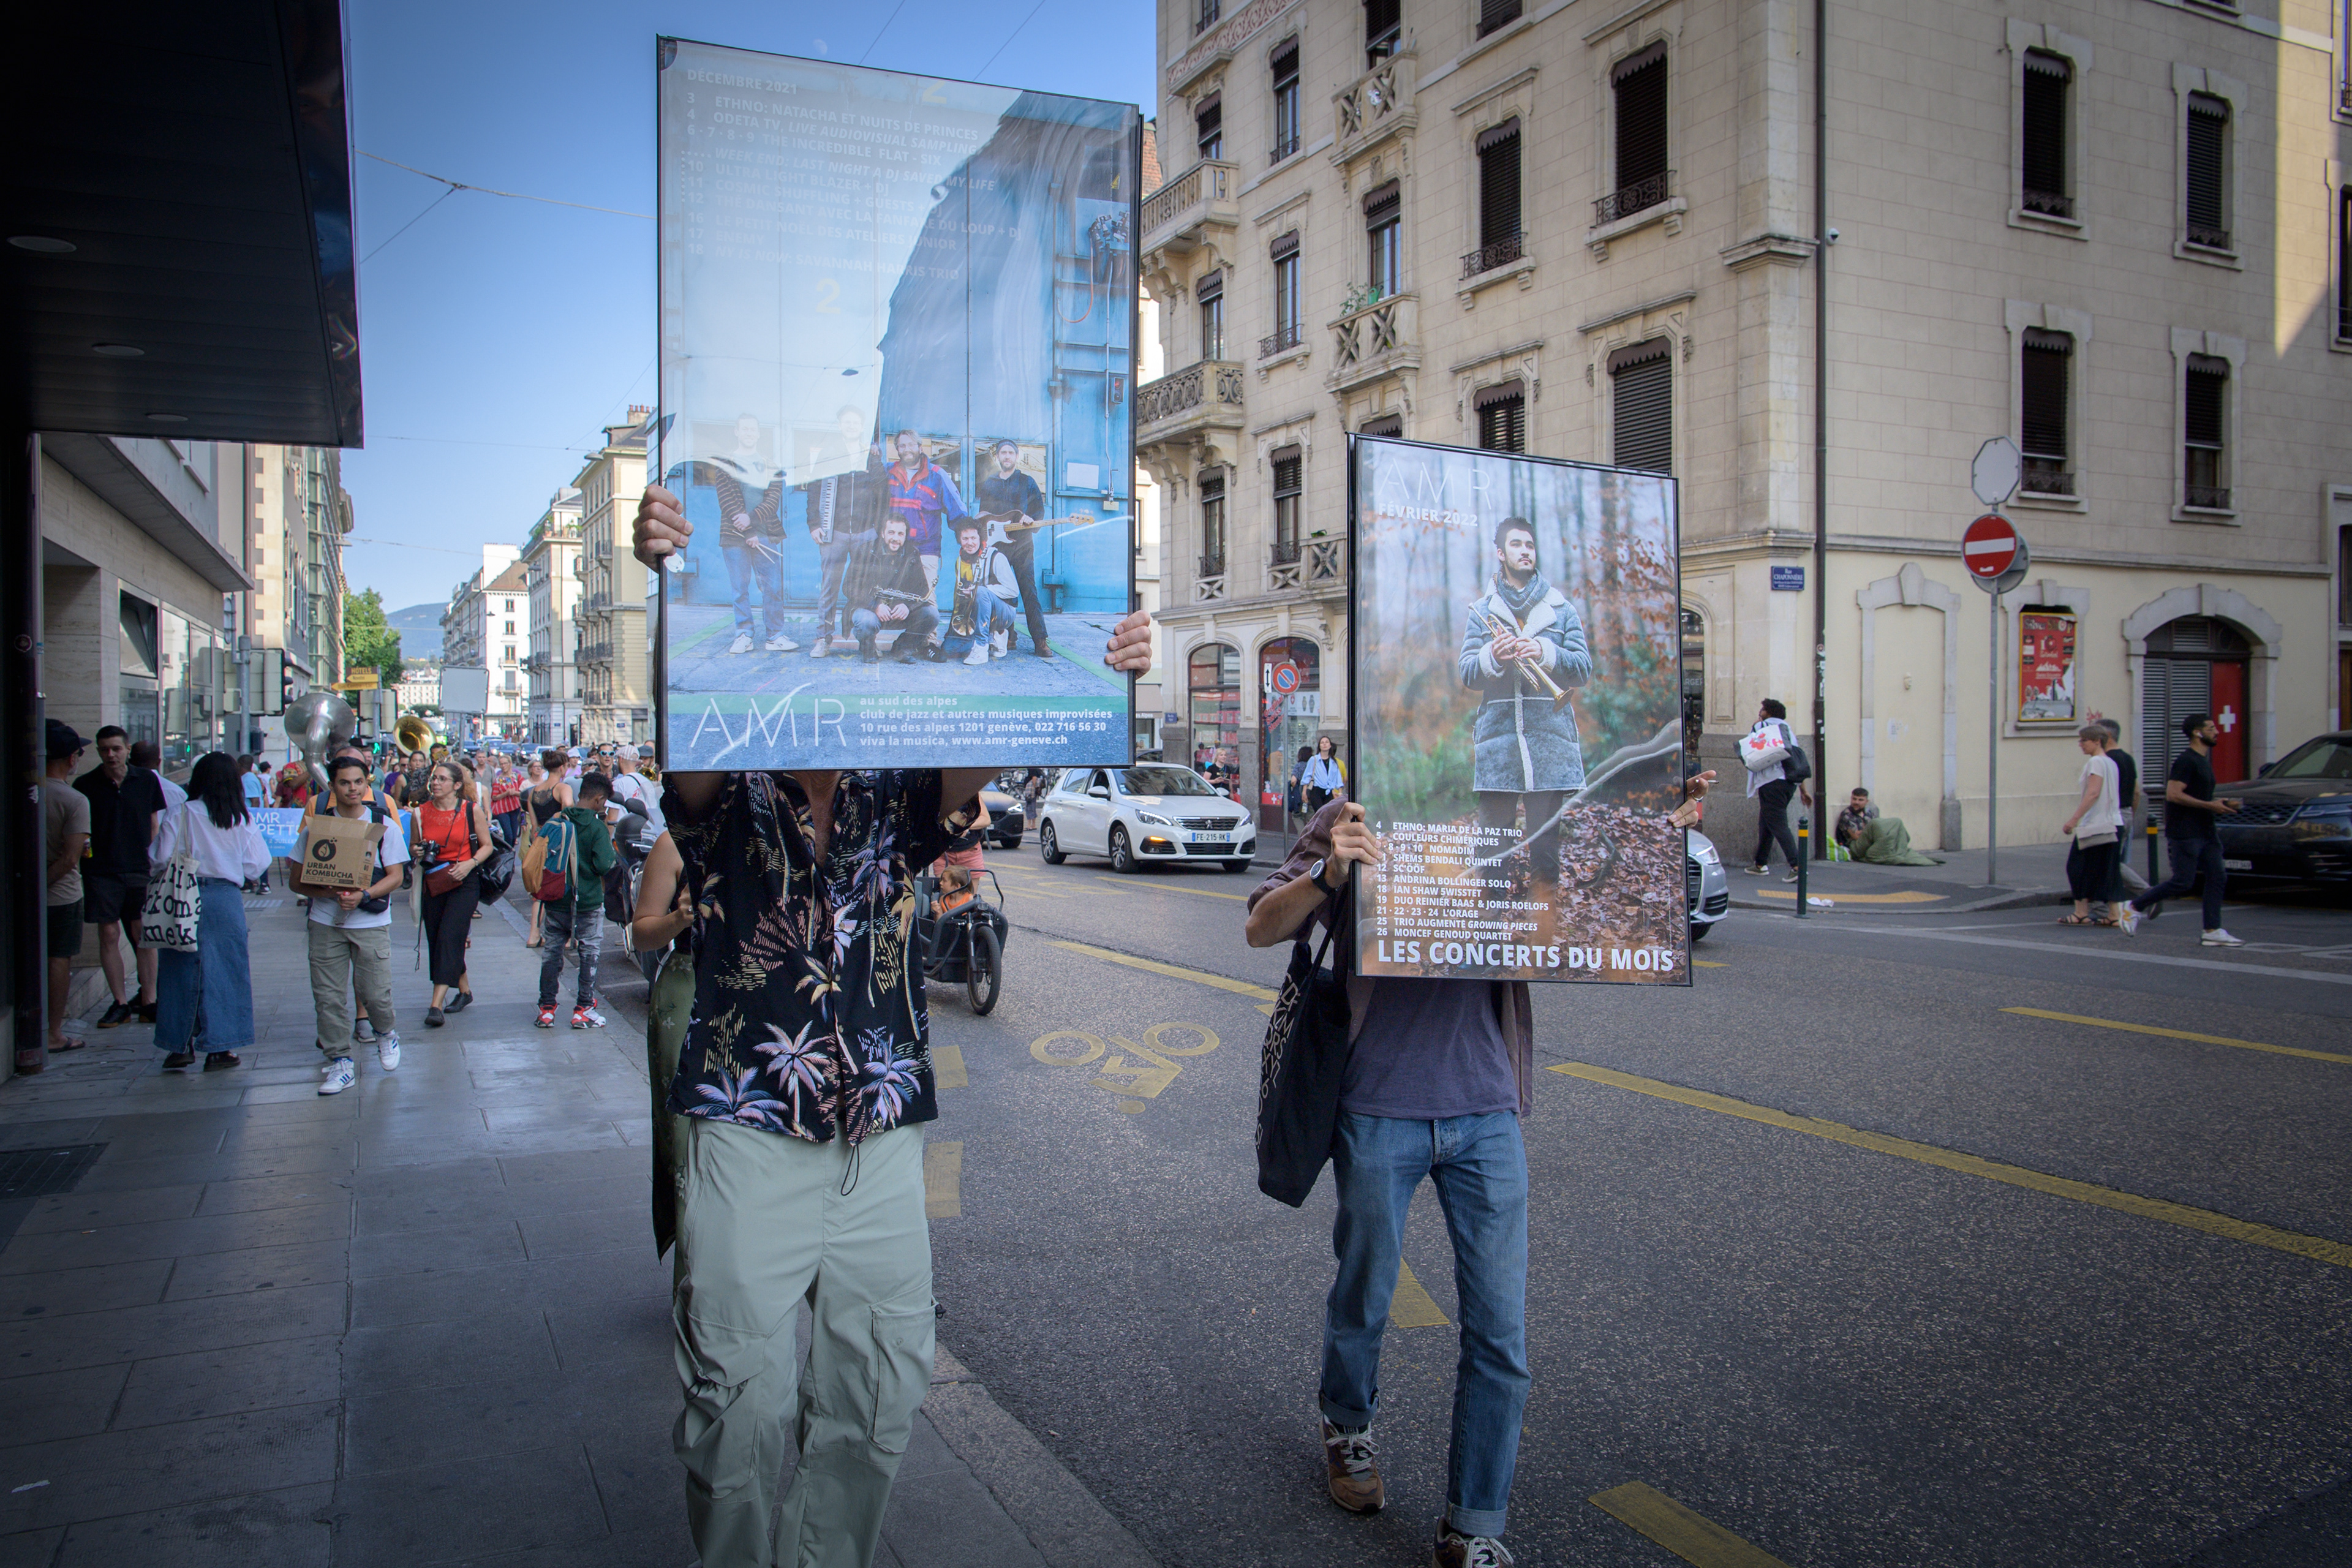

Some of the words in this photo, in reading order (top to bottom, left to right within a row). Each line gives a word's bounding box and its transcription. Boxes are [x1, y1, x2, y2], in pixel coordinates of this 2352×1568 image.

[687, 68, 761, 90] DÉCEMBRE
[766, 80, 796, 94] 2021
[715, 96, 767, 113] ETHNO:
[772, 104, 837, 122] NATACHA
[842, 113, 856, 124] ET
[860, 115, 900, 130] NUITS
[904, 121, 920, 133] DE
[924, 124, 978, 140] PRINCES
[714, 111, 760, 128] ODETA
[763, 118, 783, 133] TV,
[788, 121, 817, 135] LIVE
[820, 126, 907, 146] AUDIOVISUAL
[911, 137, 977, 154] SAMPLING
[763, 134, 788, 147] THE
[793, 137, 872, 157] INCREDIBLE
[879, 148, 909, 162] FLAT
[921, 154, 941, 166] SIX
[715, 148, 753, 162] WEEK
[756, 153, 789, 167] END:
[793, 157, 825, 171] LAST
[828, 161, 870, 176] NIGHT
[886, 168, 899, 183] DJ
[903, 170, 943, 184] SAVED
[946, 176, 966, 187] MY
[968, 178, 995, 191] LIFE
[688, 160, 704, 172] 10
[715, 163, 761, 179] ULTRA
[766, 169, 806, 184] LIGHT
[810, 175, 861, 191] BLAZER
[876, 183, 888, 197] DJ
[688, 176, 703, 187] 11
[715, 179, 770, 195] COSMIC
[774, 186, 850, 205] SHUFFLING
[865, 197, 914, 211] GUESTS
[688, 192, 704, 204] 12
[715, 194, 742, 208] THÉ
[746, 198, 813, 216] DANSANT
[817, 206, 851, 220] AVEC
[856, 211, 873, 222] LA
[938, 219, 957, 232] DU
[961, 222, 995, 235] LOUP
[1009, 227, 1022, 241] DJ
[688, 212, 703, 224] 16
[716, 214, 731, 227] LE
[736, 217, 772, 231] PETIT
[777, 221, 813, 235] NOËL
[818, 225, 842, 238] DES
[846, 228, 905, 244] ATELIERS
[688, 227, 704, 239] 17
[716, 230, 765, 245] ENEMY
[688, 243, 704, 254] 18
[796, 254, 872, 271] SAVANNAH
[929, 267, 959, 280] TRIO
[816, 279, 842, 314] 2
[1378, 458, 1492, 510] AMR
[1379, 502, 1439, 522] FÉVRIER
[1443, 511, 1478, 527] 2022
[878, 696, 899, 706] sud
[903, 696, 923, 706] des
[926, 696, 957, 708] alpes
[690, 697, 846, 748] AMR
[860, 709, 885, 718] club
[889, 709, 903, 718] de
[906, 709, 929, 721] jazz
[932, 710, 944, 718] et
[948, 710, 985, 718] autres
[988, 709, 1042, 721] musiques
[1046, 709, 1112, 721] improvisées
[860, 723, 874, 732] 10
[900, 723, 921, 733] des
[924, 722, 955, 734] alpes
[959, 723, 984, 732] 1201
[987, 722, 1031, 734] genève,
[1035, 722, 1054, 731] 022
[1057, 722, 1076, 731] 716
[1079, 722, 1091, 731] 56
[1094, 722, 1106, 731] 30
[860, 736, 886, 746] viva
[889, 736, 899, 745] la
[903, 736, 948, 747] musica,
[952, 735, 1068, 747] www.amr-geneve.ch
[1393, 822, 1425, 831] ETHNO:
[1428, 824, 1457, 834] MARIA
[1472, 826, 1483, 835] LA
[1502, 829, 1523, 837] TRIO
[1393, 832, 1438, 843] COULEURS
[1440, 834, 1499, 846] CHIMÉRIQUES
[1430, 845, 1475, 855] NOMADIM
[1393, 853, 1423, 862] SHEMS
[1425, 855, 1462, 865] BENDALI
[1464, 857, 1502, 867] QUINTET
[1393, 863, 1425, 873] SC'ÖÖF
[306, 869, 353, 879] KOMBUCHA
[1393, 875, 1436, 885] ANDRINA
[1438, 877, 1487, 888] BOLLINGER
[1488, 880, 1511, 888] SOLO
[1412, 886, 1439, 895] SHAW
[1441, 888, 1482, 897] 5WISSTET
[1394, 896, 1414, 905] DUO
[1415, 897, 1450, 907] REINIER
[1452, 899, 1474, 908] BAAS
[1485, 900, 1510, 910] JORIS
[1512, 901, 1549, 911] ROELOFS
[1377, 906, 1387, 914] 21
[1411, 907, 1422, 916] 23
[1442, 908, 1479, 918] L'ORAGE
[1394, 918, 1415, 926] TRIO
[1468, 921, 1508, 930] GROWING
[1510, 922, 1538, 931] PIECES
[1377, 927, 1387, 936] 26
[1394, 928, 1431, 938] MONCEF
[1434, 930, 1470, 939] GENOUD
[1473, 931, 1512, 941] QUARTET
[1378, 940, 1420, 963] LES
[1429, 942, 1561, 968] CONCERTS
[1569, 948, 1602, 969] DU
[1611, 949, 1674, 972] MOIS
